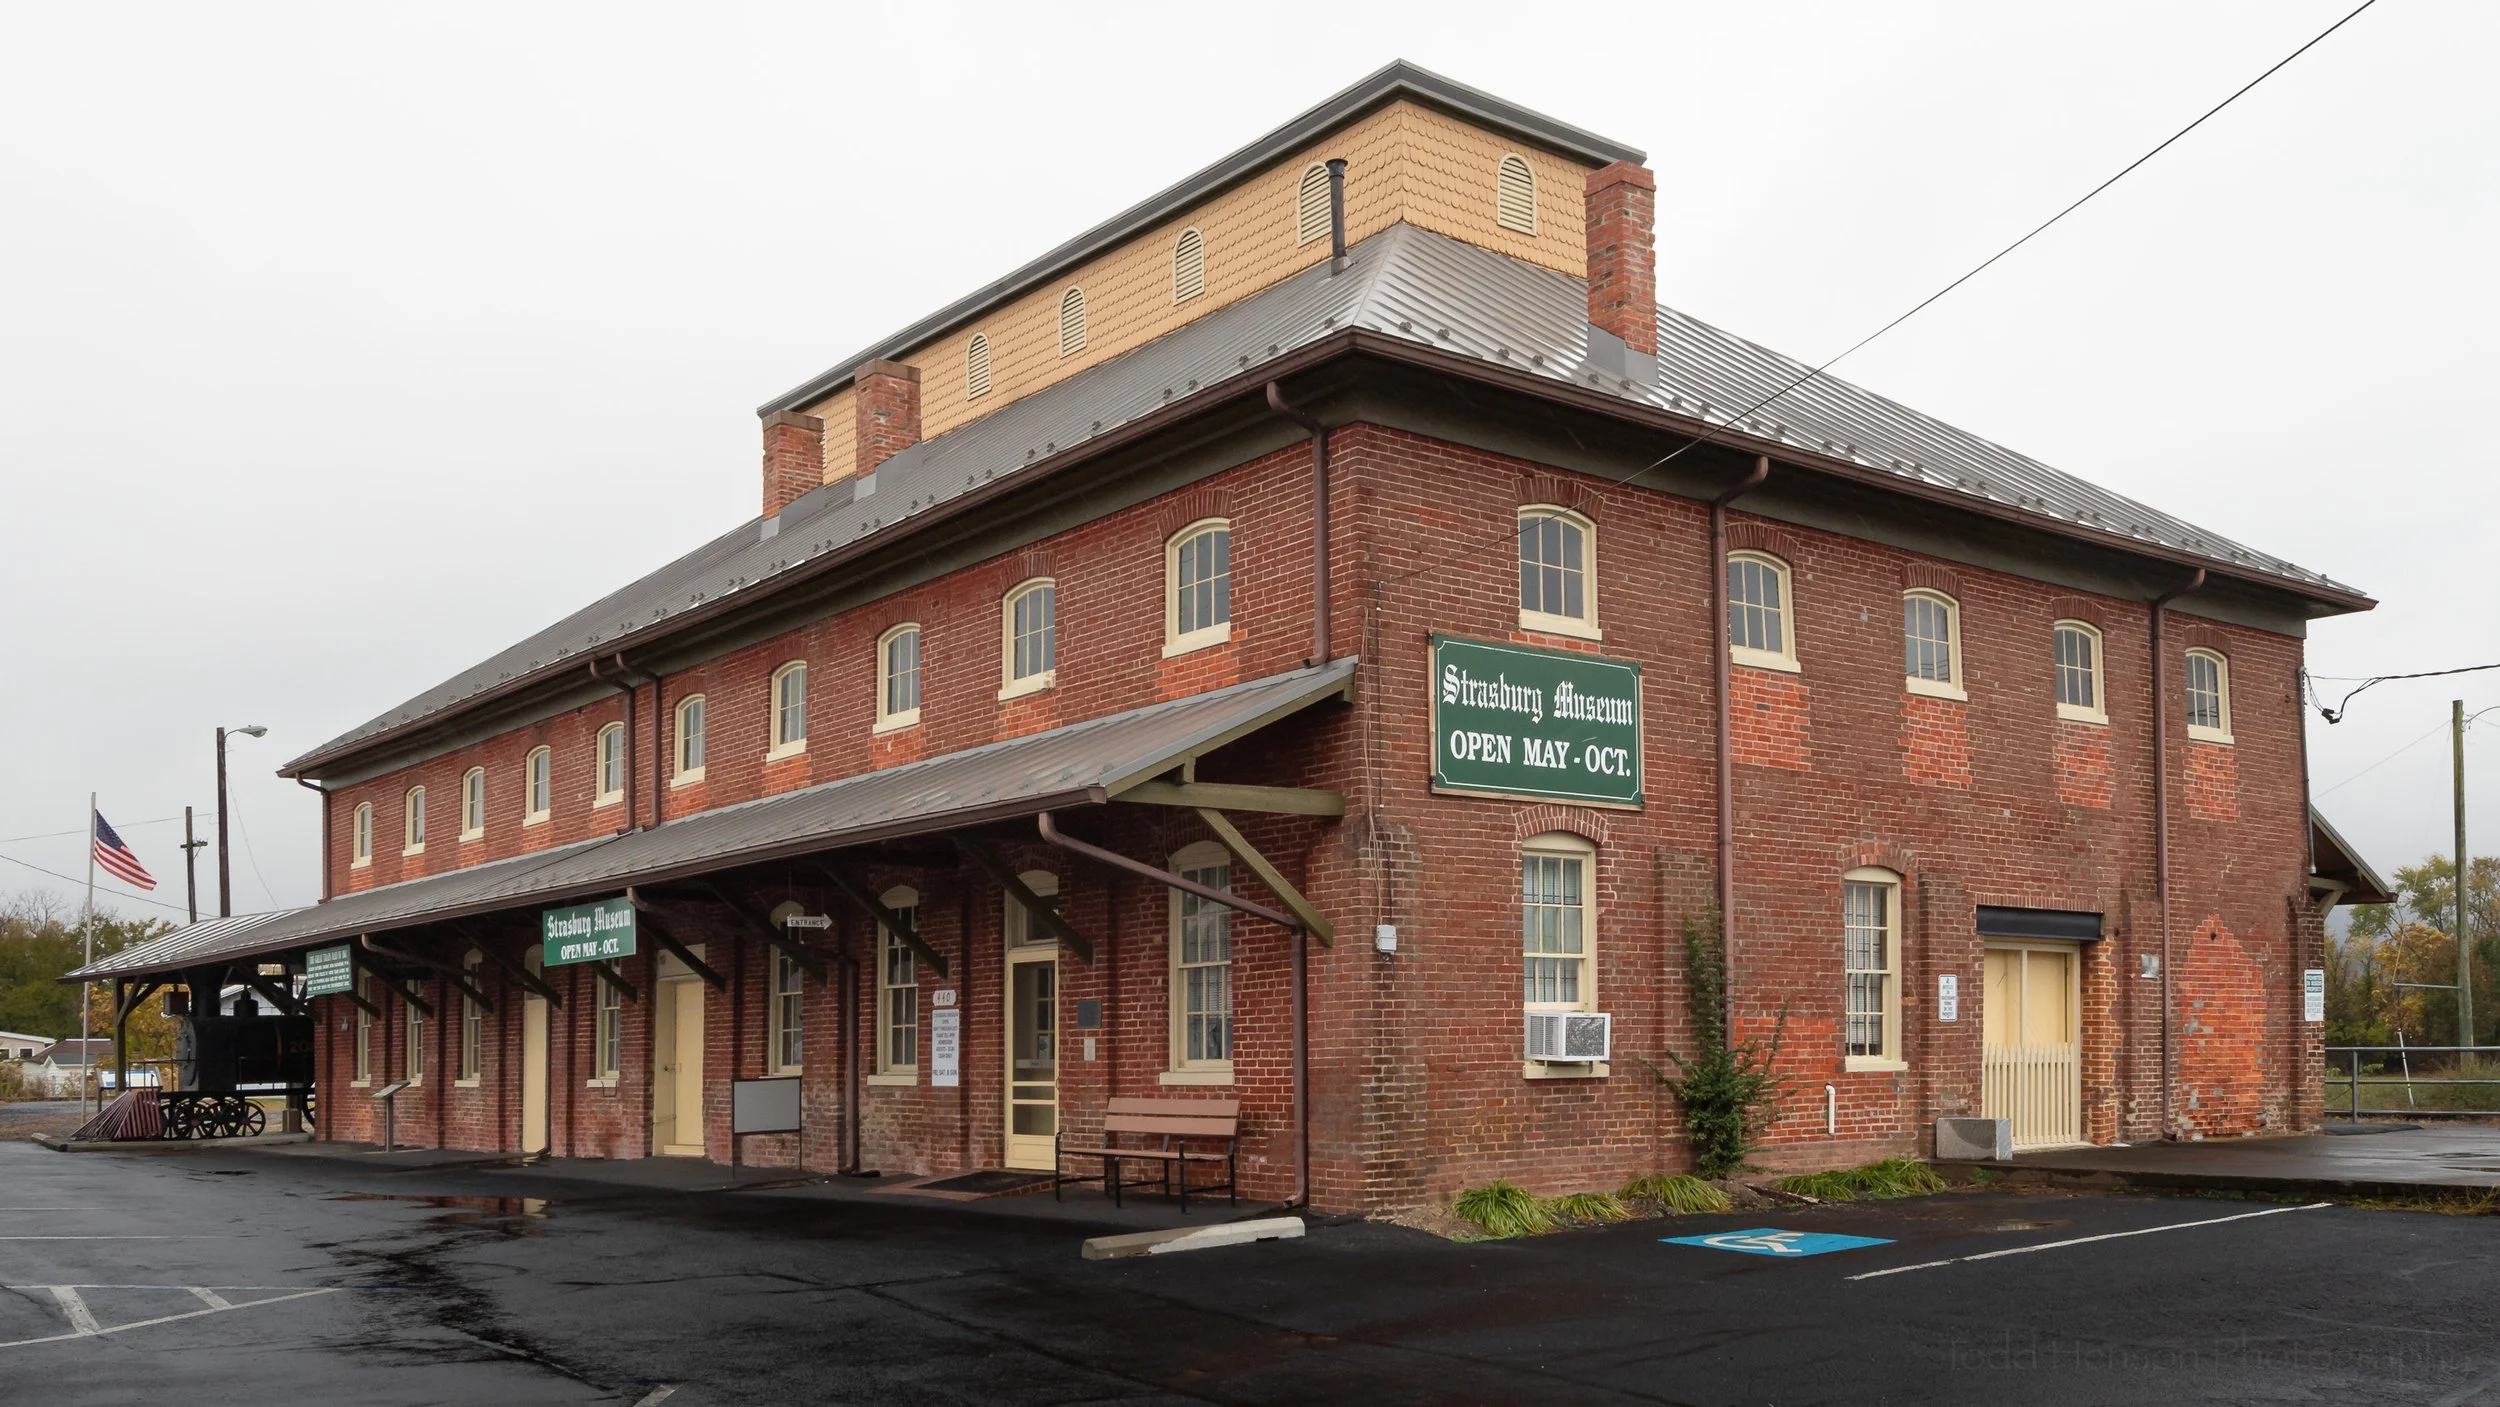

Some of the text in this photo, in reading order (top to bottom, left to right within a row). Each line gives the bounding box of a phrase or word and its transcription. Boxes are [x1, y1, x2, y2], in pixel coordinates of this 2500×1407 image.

[1442, 664, 1633, 726] Strasburg Museum
[1450, 730, 1512, 764] OPEN
[547, 906, 631, 941] Strasburg Museum
[561, 943, 581, 960] OPEN
